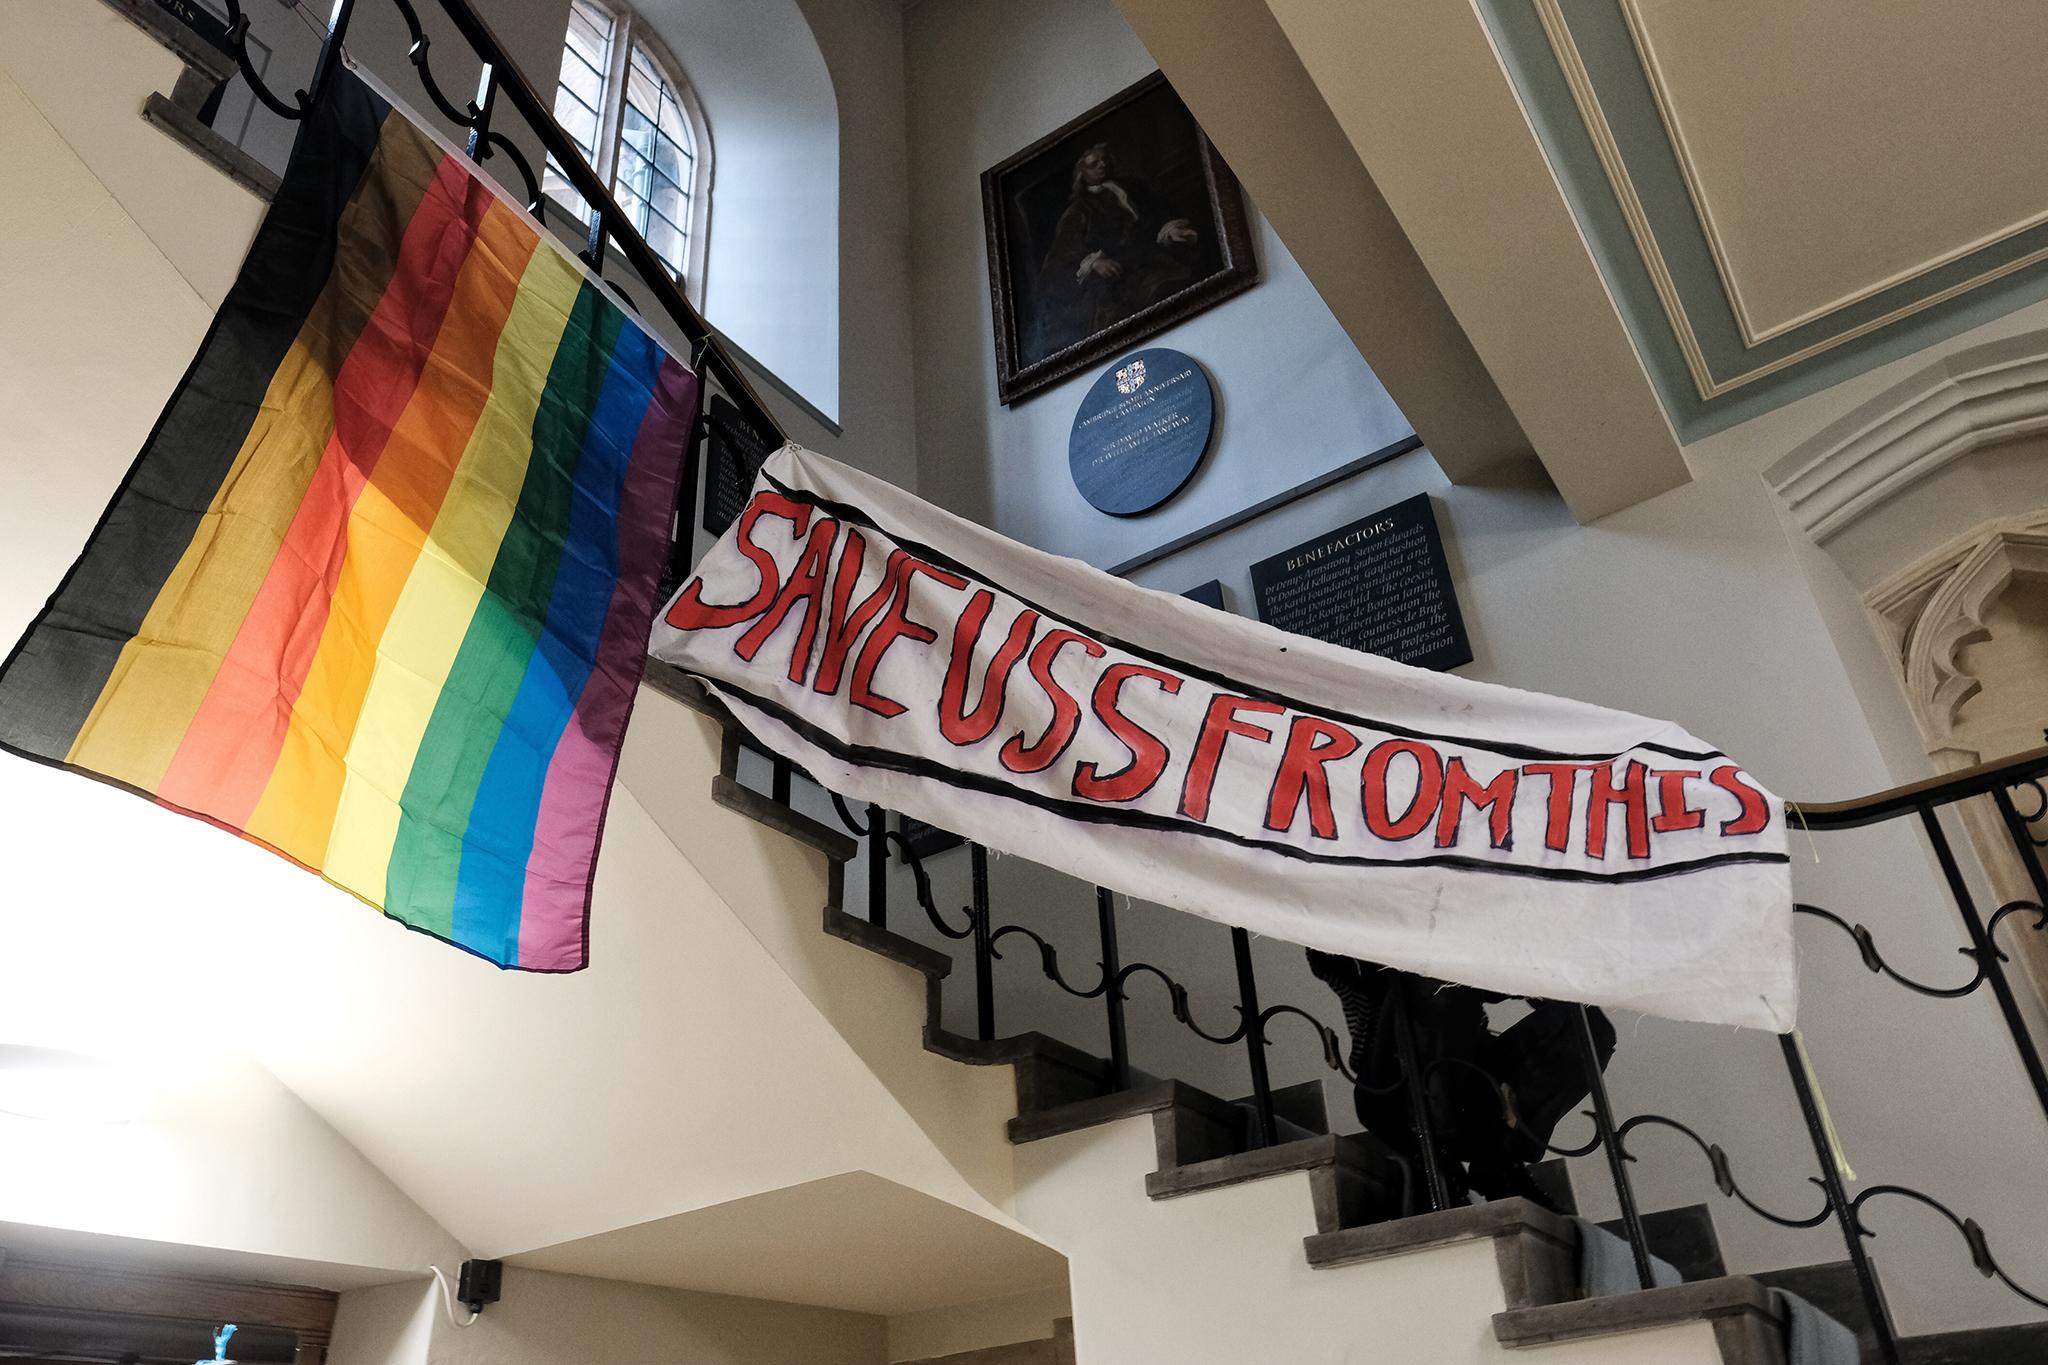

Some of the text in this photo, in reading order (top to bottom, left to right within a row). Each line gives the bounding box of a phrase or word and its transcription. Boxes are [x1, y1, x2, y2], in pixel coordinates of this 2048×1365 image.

[1265, 585, 1276, 596] Dr
[1304, 554, 1351, 580] Armstrong
[1383, 523, 1424, 547] Edwards
[1286, 518, 1394, 571] BENEFACTORS
[1266, 535, 1426, 607] Dr Donald Kellaway Graham Rushton
[1308, 574, 1359, 601] Foundation
[1364, 553, 1404, 579] Gaylord
[1406, 543, 1429, 561] and
[1355, 564, 1412, 594] Foundation
[1305, 613, 1318, 625] de
[1318, 590, 1370, 620] Rothschild
[1381, 582, 1398, 595] The
[1399, 567, 1434, 588] Coexist
[1335, 612, 1351, 626] The
[1352, 606, 1365, 618] de
[1373, 610, 1386, 623] de
[1421, 589, 1441, 603] The
[1358, 617, 1402, 641] Countess
[1403, 610, 1417, 623] de
[1369, 621, 1426, 649] Foundation
[1430, 611, 1447, 626] The
[1401, 624, 1451, 649] Professor
[664, 490, 968, 719] SAVE
[1176, 693, 1520, 852] FROM
[1522, 759, 1771, 860] THIS
